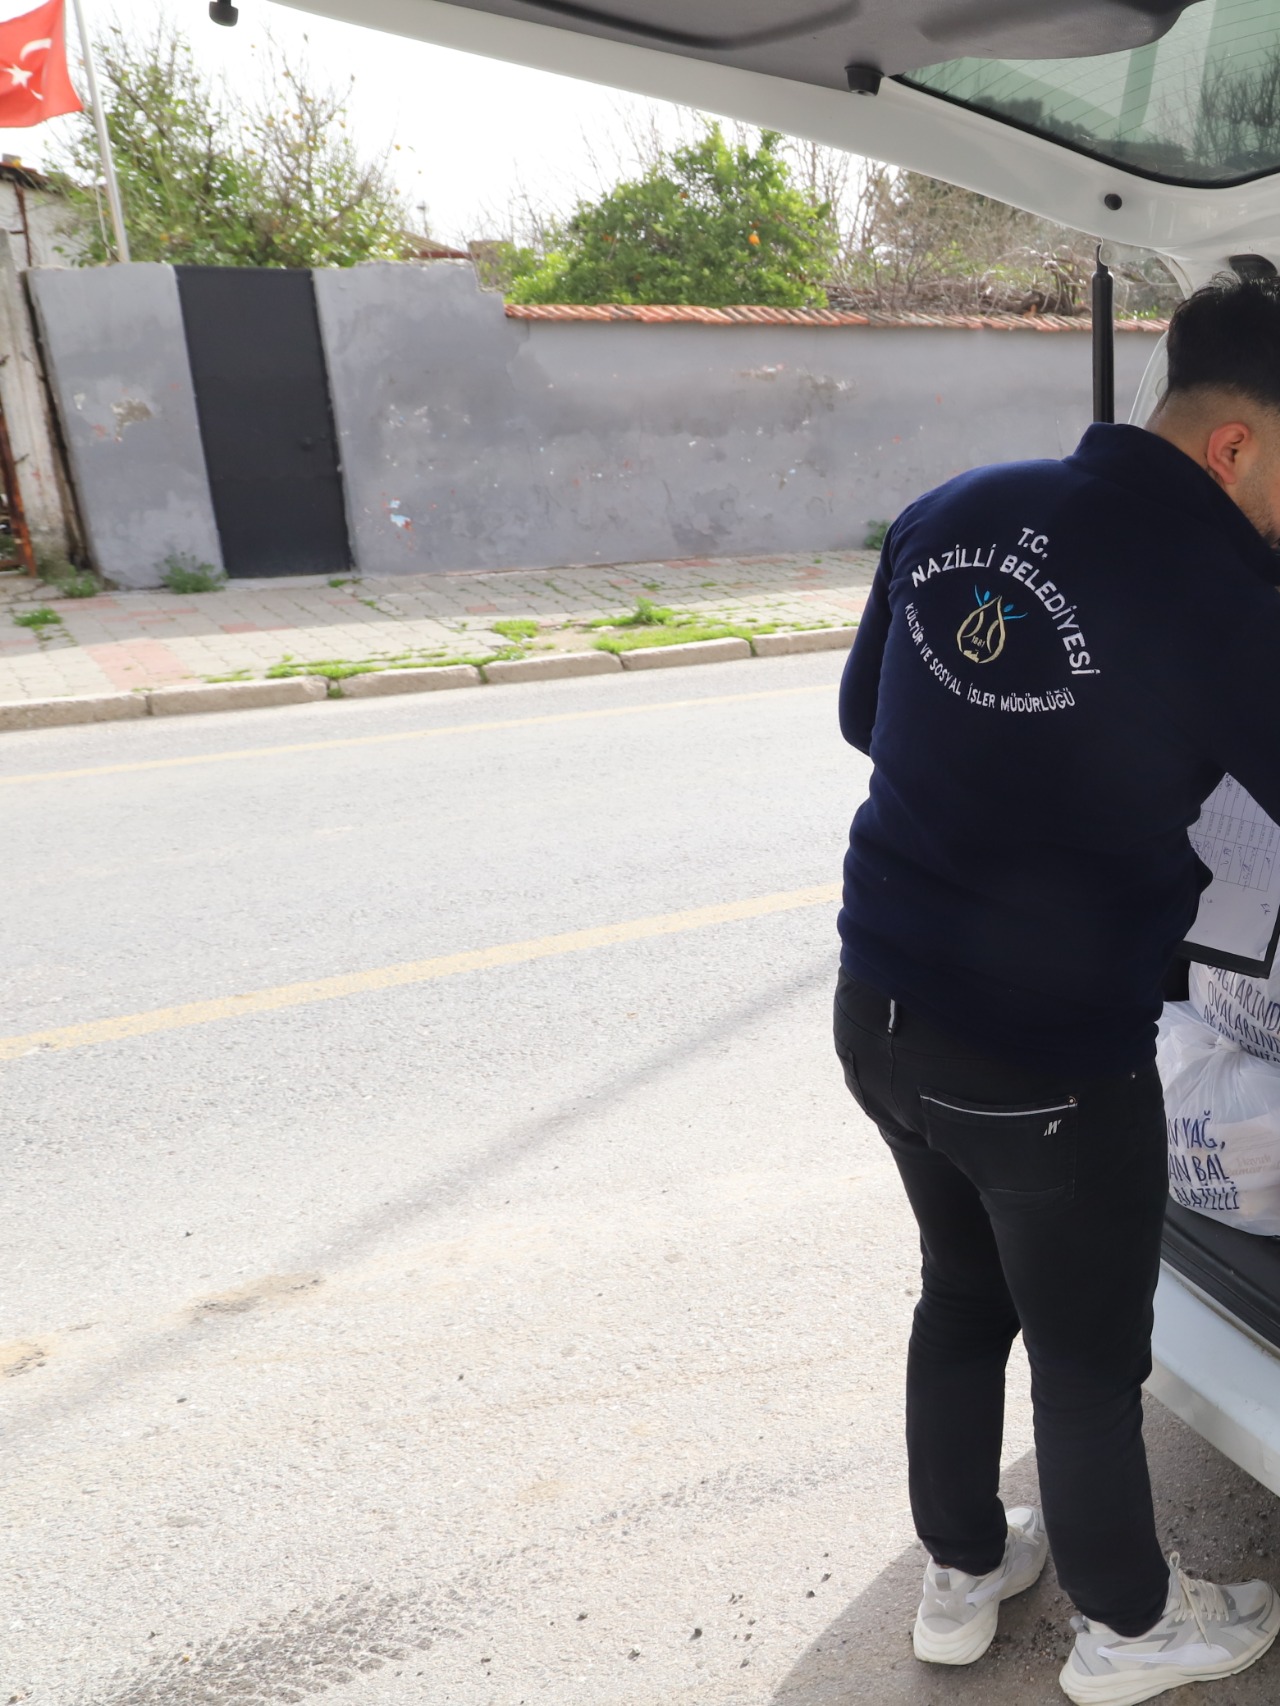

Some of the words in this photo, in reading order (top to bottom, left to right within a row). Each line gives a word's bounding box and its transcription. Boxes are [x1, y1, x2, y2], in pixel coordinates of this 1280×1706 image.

[1017, 527, 1050, 559] T.C.
[911, 543, 997, 588] NAZİLLİ
[999, 554, 1101, 675] BELEDİYESİ
[904, 602, 925, 646] KÜLTÜR
[919, 643, 932, 663] VE
[929, 658, 962, 696] SOSYAL
[966, 682, 996, 709] İŞLER
[1000, 687, 1076, 713] MÜDÜRLÜĞÜ
[1182, 1110, 1226, 1149] YAĞ,
[1191, 1153, 1230, 1182] BAL
